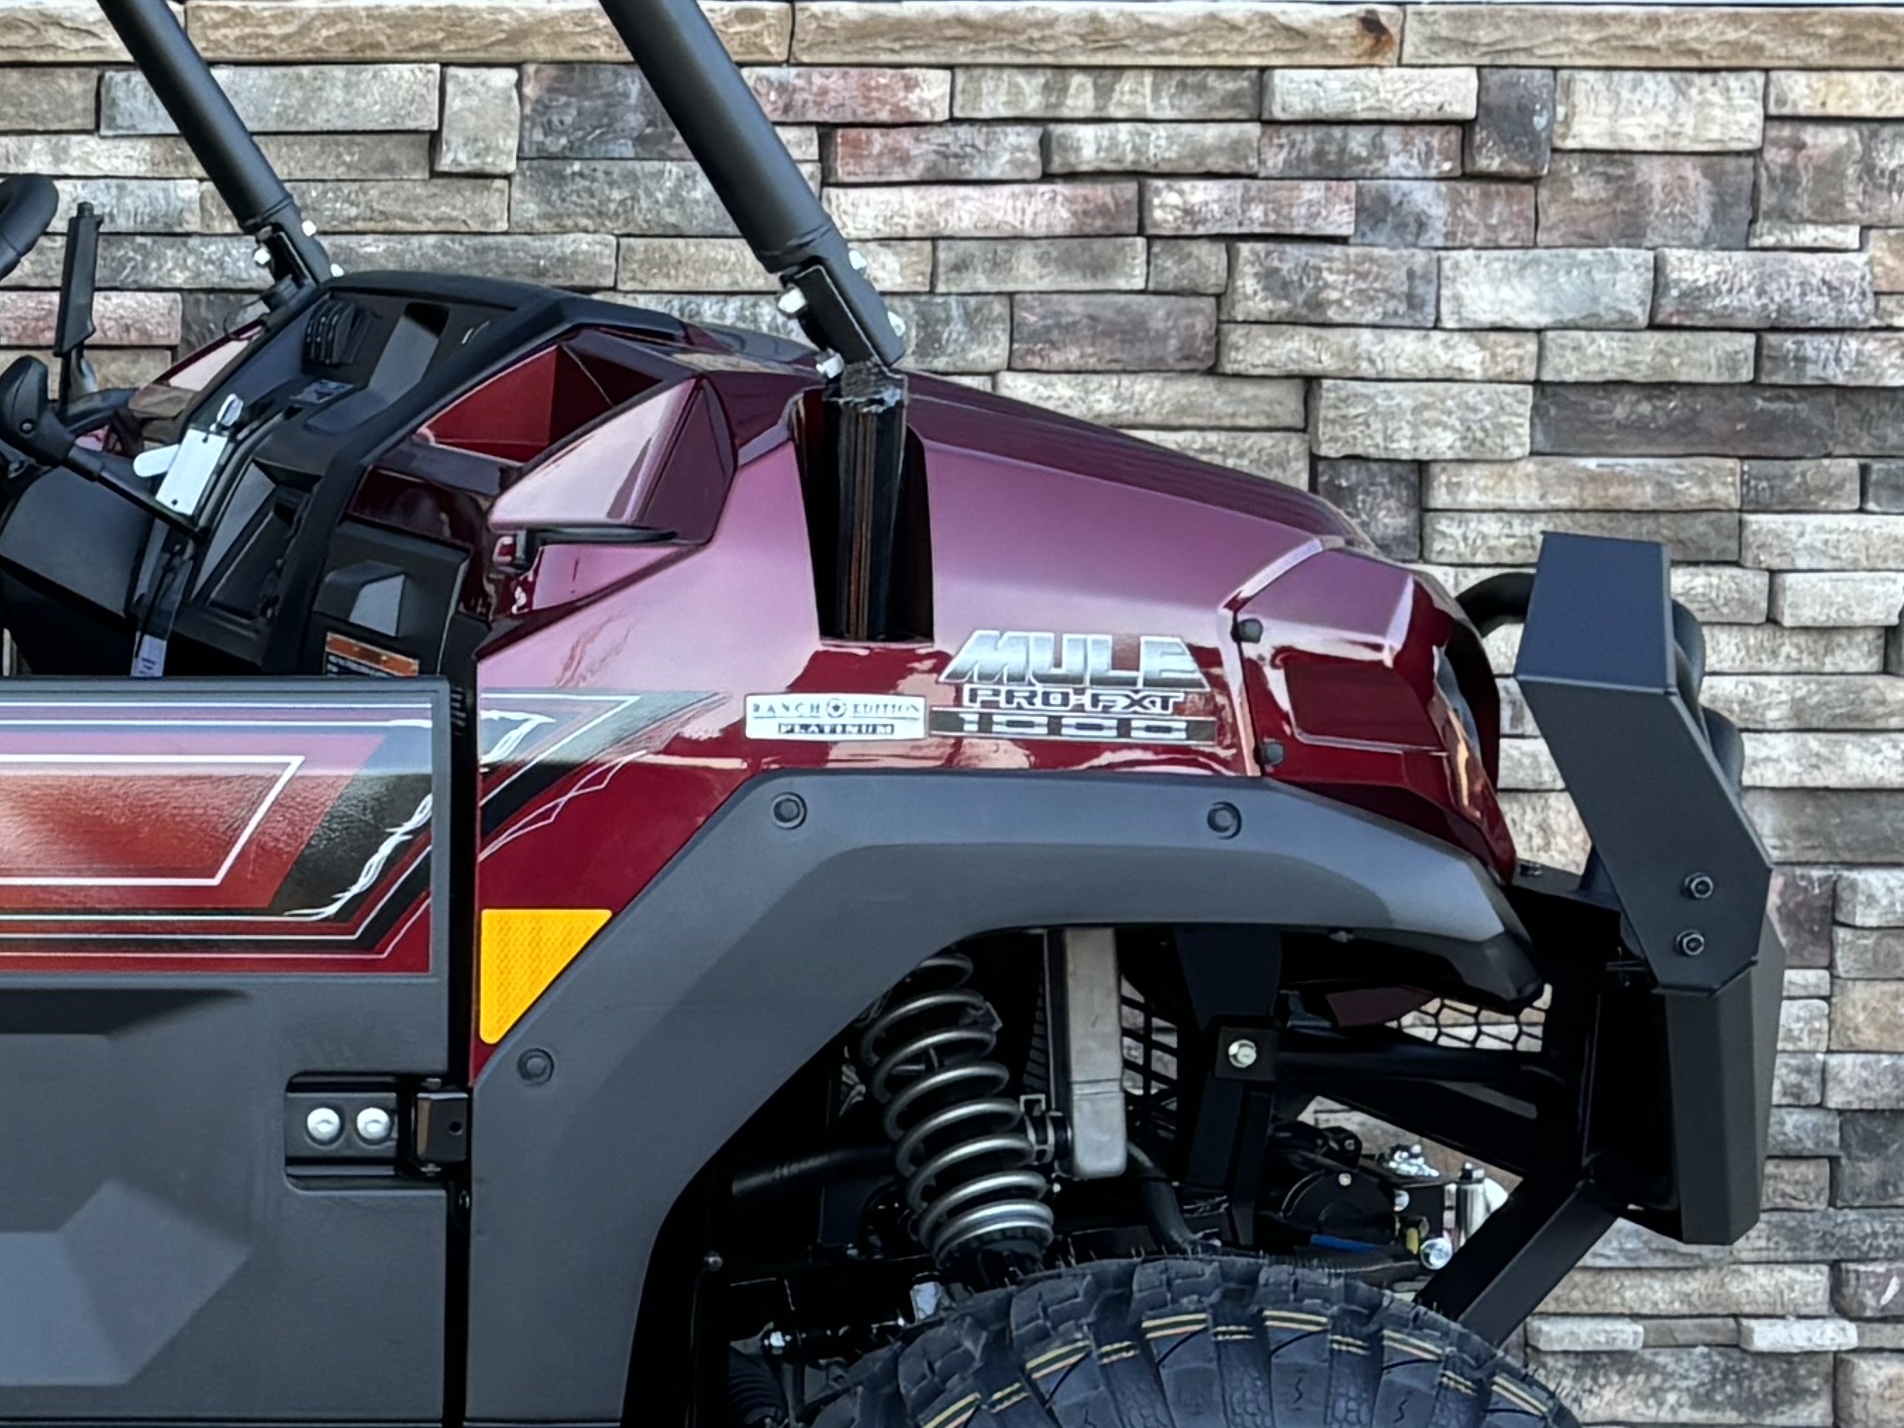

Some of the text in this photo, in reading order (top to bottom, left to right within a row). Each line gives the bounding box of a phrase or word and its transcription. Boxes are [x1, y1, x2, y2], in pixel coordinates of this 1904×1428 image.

[938, 629, 1211, 692] MULE
[752, 702, 920, 714] RANCH EDITION
[963, 684, 1184, 714] PRO-FXT
[778, 722, 895, 735] PLATINUM
[959, 713, 1188, 740] 1000
